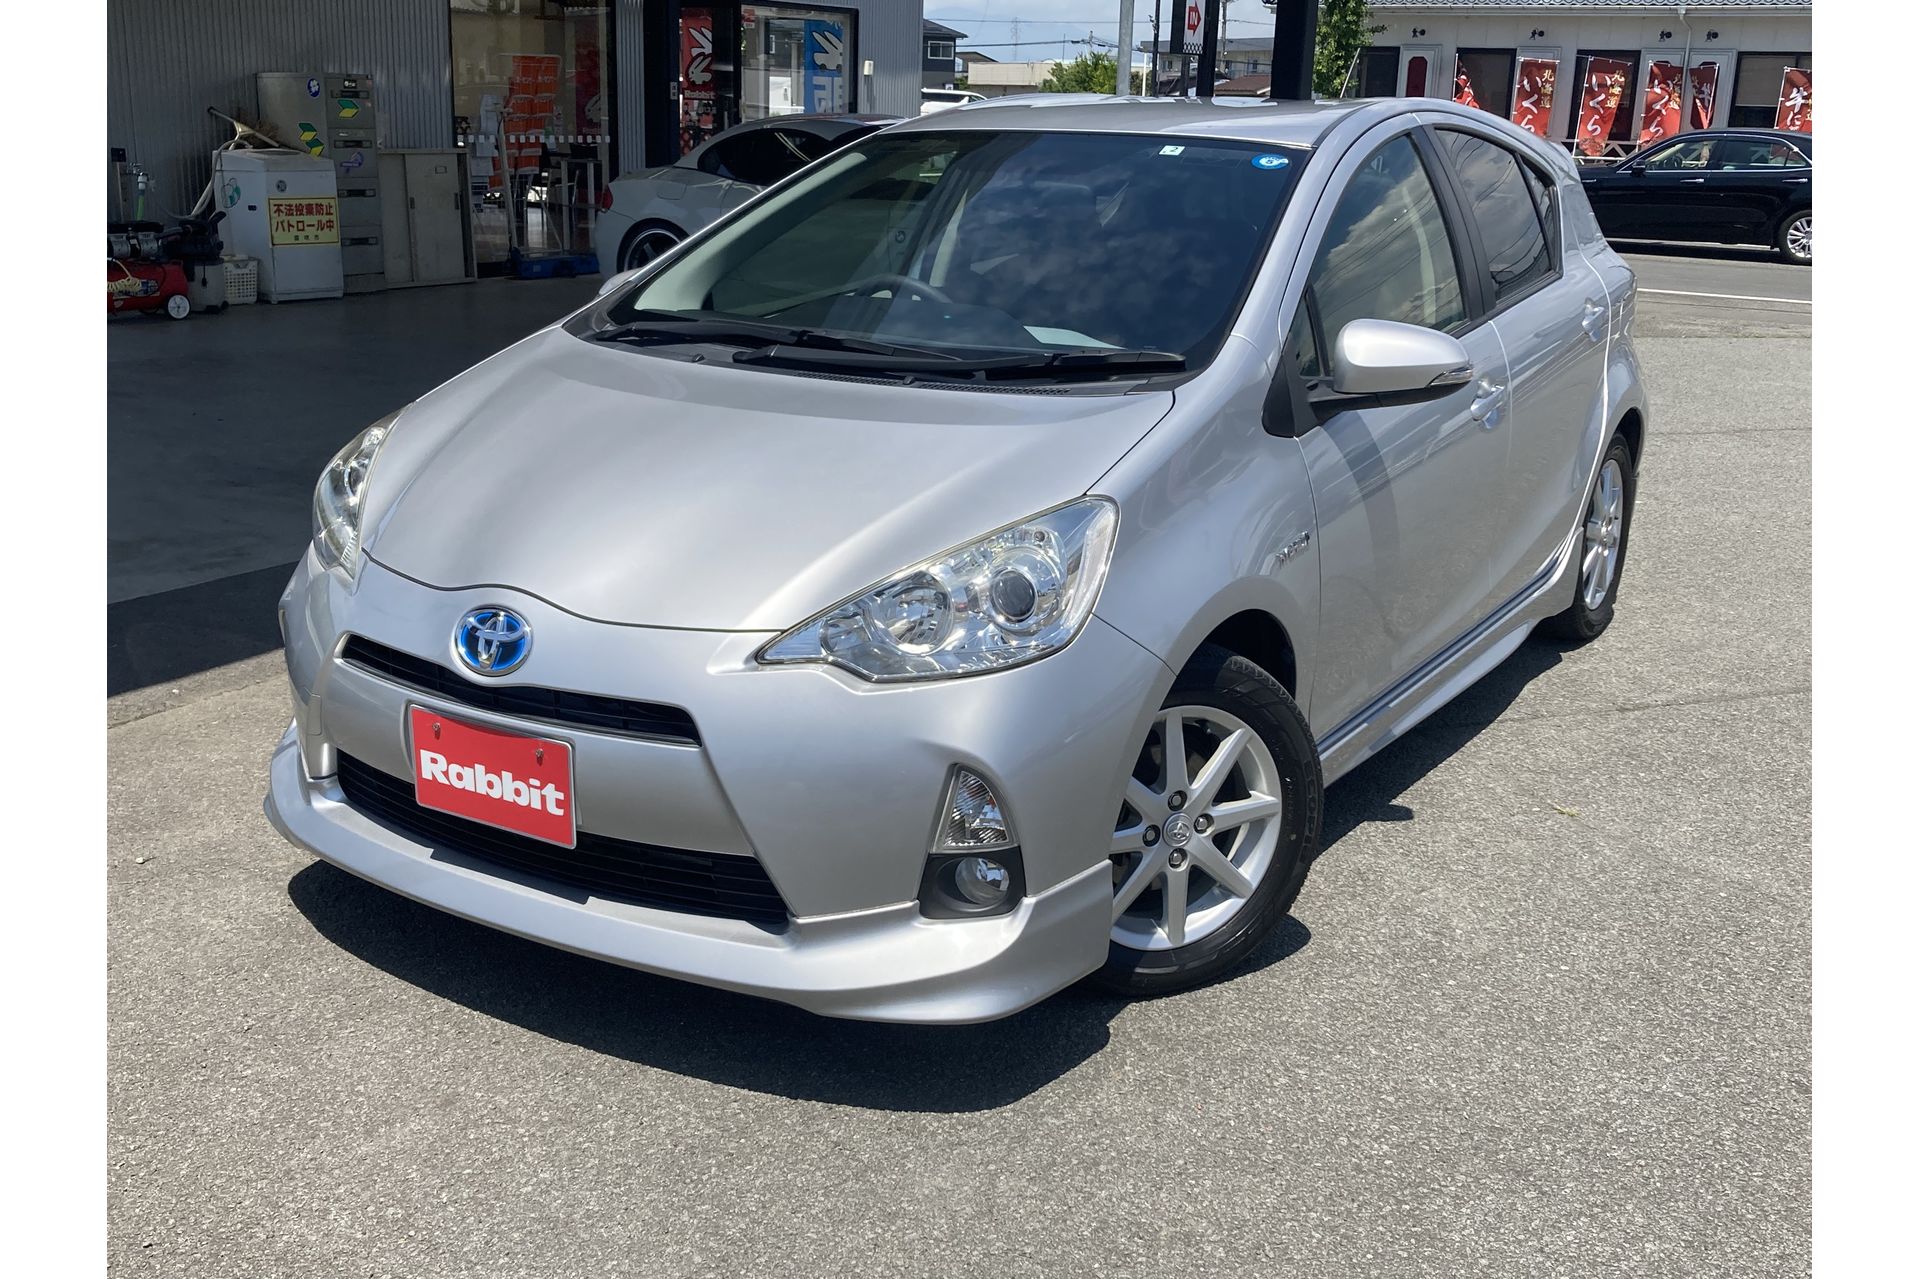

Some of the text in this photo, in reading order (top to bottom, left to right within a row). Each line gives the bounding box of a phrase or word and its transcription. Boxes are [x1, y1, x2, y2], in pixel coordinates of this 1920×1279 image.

[1520, 75, 1542, 132] いくら
[1586, 73, 1612, 136] いくら
[420, 749, 565, 816] Rabbit
